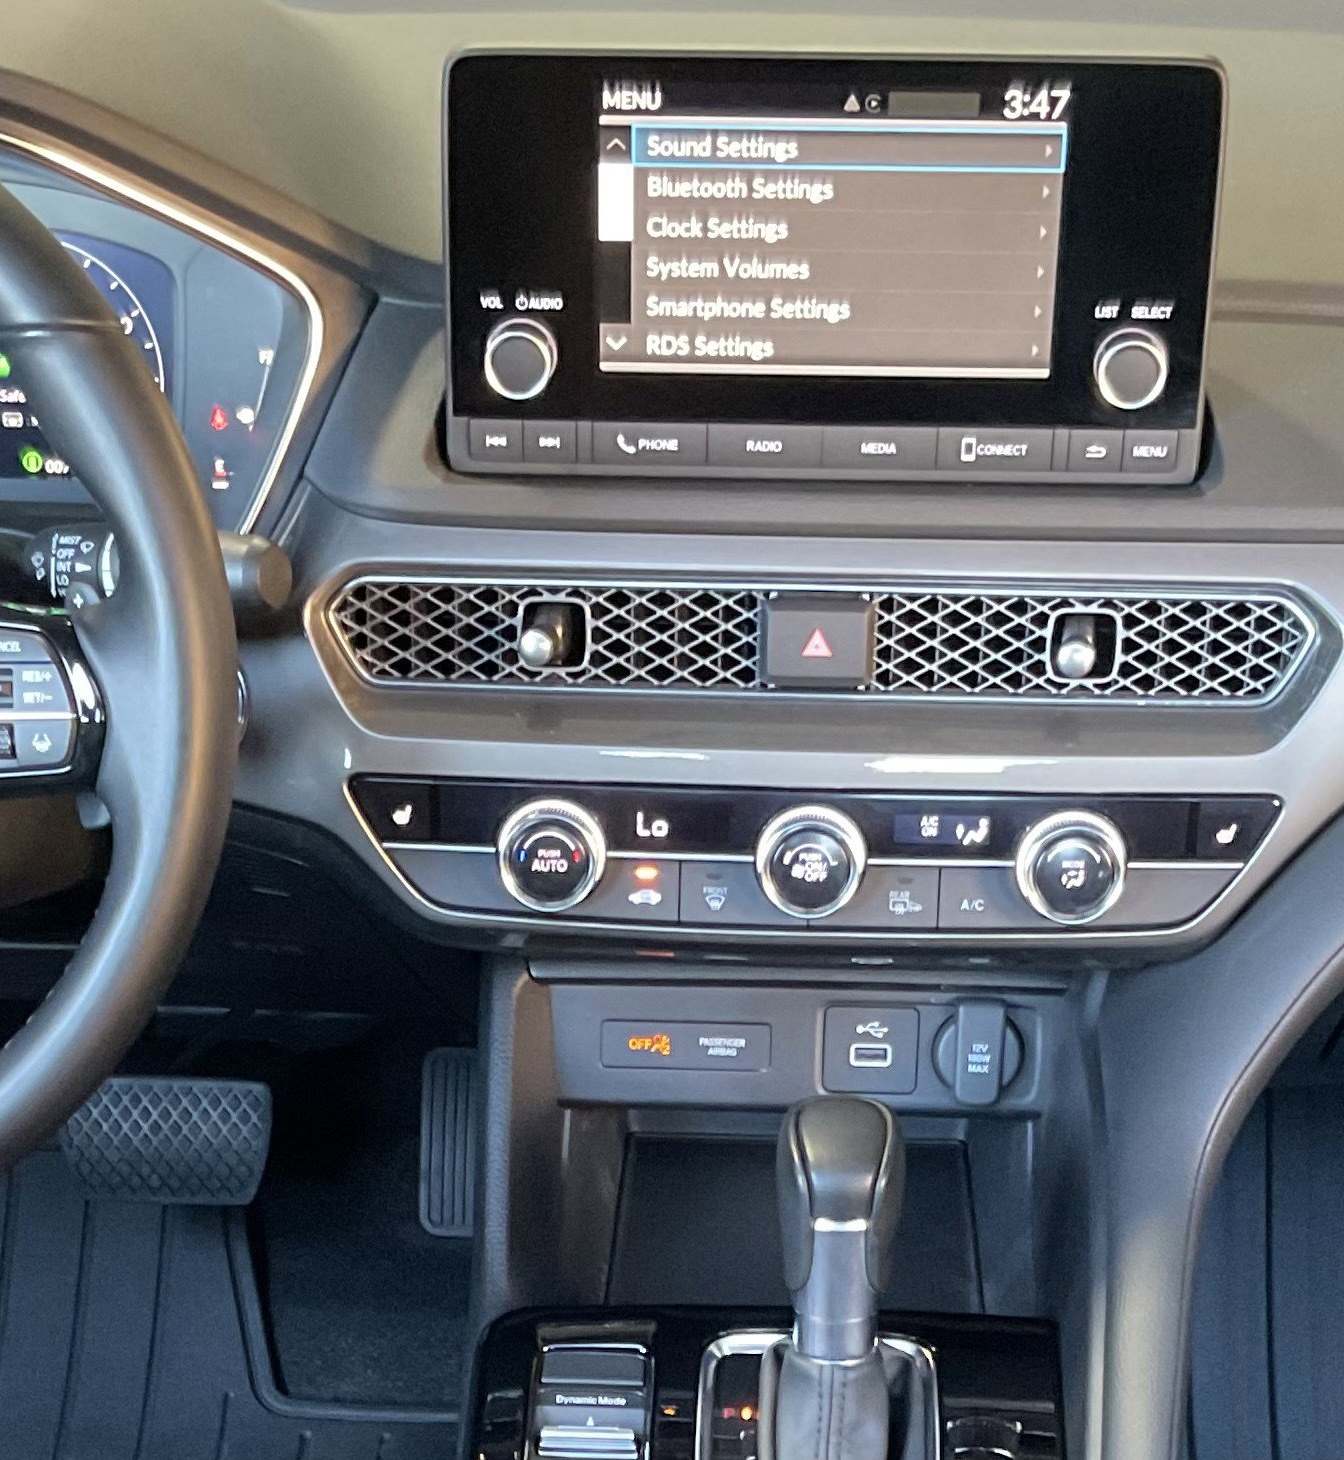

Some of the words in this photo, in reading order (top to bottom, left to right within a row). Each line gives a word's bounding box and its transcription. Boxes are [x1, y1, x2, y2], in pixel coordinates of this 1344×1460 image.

[602, 89, 662, 111] MENU
[1003, 88, 1071, 120] 3:47
[647, 135, 711, 157] Sound
[716, 137, 799, 163] Settings
[647, 176, 748, 199] Bluetooth
[752, 178, 834, 204] Settings
[646, 216, 703, 239] Clock
[707, 217, 789, 244] Settings
[646, 256, 719, 281] System
[723, 256, 810, 280] Volumes
[480, 296, 504, 309] VOL
[529, 297, 564, 310] AUDIO
[646, 295, 766, 321] Smartphone
[770, 297, 851, 324] Settings
[1094, 305, 1119, 318] LIST
[1131, 306, 1173, 319] SELECT
[646, 334, 690, 356] RDS
[694, 335, 774, 361] Settings
[637, 438, 679, 451] PHONE
[745, 440, 783, 453] RADIO
[860, 442, 897, 455] MEDIA
[976, 443, 1028, 457] CONNECT
[1132, 446, 1168, 458] MENU
[57, 548, 75, 559] OFF
[56, 574, 69, 587] LO
[636, 811, 669, 838] Lo
[920, 816, 939, 827] A/C
[921, 827, 938, 838] ON
[531, 858, 568, 873] AUTO
[960, 899, 985, 912] A/C
[628, 1038, 652, 1051] OFF
[556, 1394, 597, 1405] Dynamic
[598, 1396, 627, 1406] Mode
